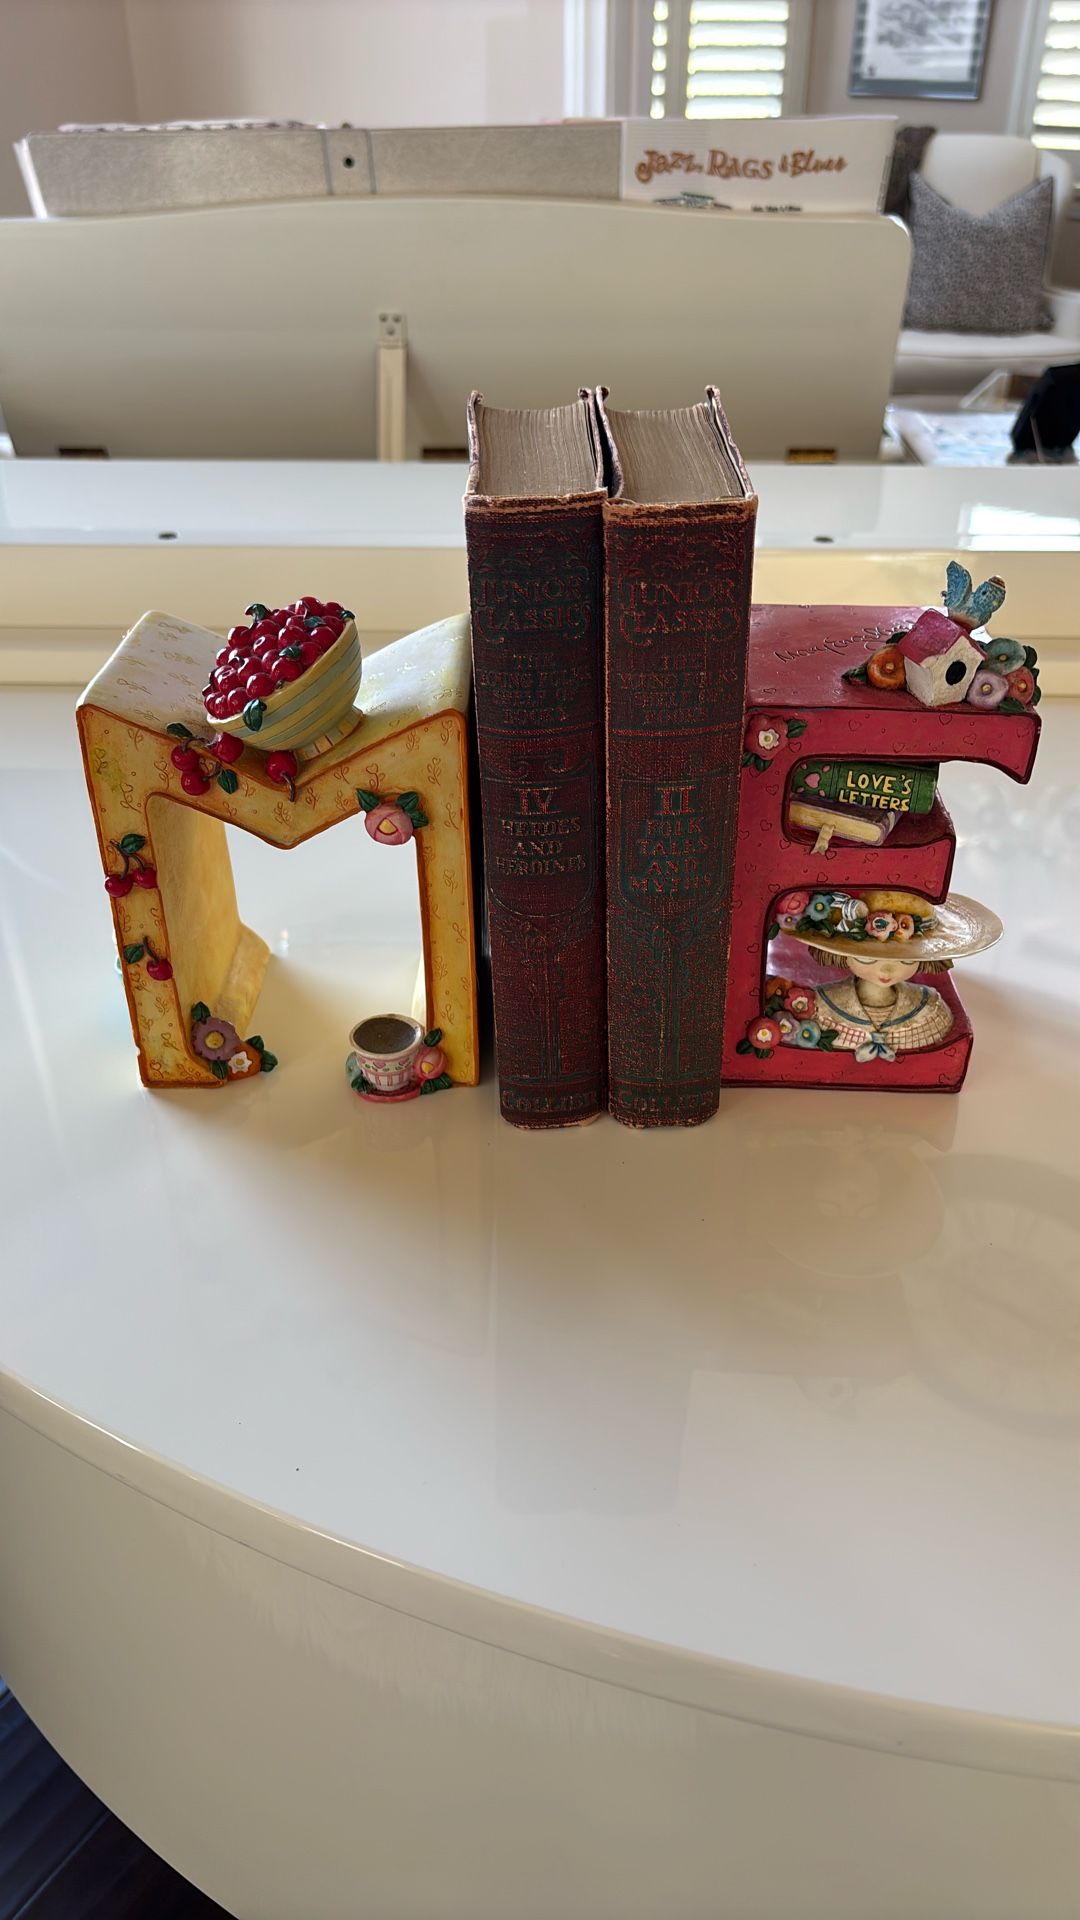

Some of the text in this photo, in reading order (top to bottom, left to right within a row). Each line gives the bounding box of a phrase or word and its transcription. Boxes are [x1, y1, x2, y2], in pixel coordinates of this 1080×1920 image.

[791, 148, 848, 178] Blues
[475, 576, 585, 606] JUNIOR
[619, 577, 736, 610] JUNIOR
[846, 770, 913, 796] LOVE'S
[515, 784, 562, 816] IV
[654, 784, 697, 816] II
[838, 789, 911, 812] LETTERS
[500, 816, 582, 837] HEROES
[647, 815, 705, 838] FOLK
[513, 840, 563, 857] AND
[638, 836, 709, 858] TALES
[649, 858, 698, 877] AND
[630, 873, 713, 894] MYTHS
